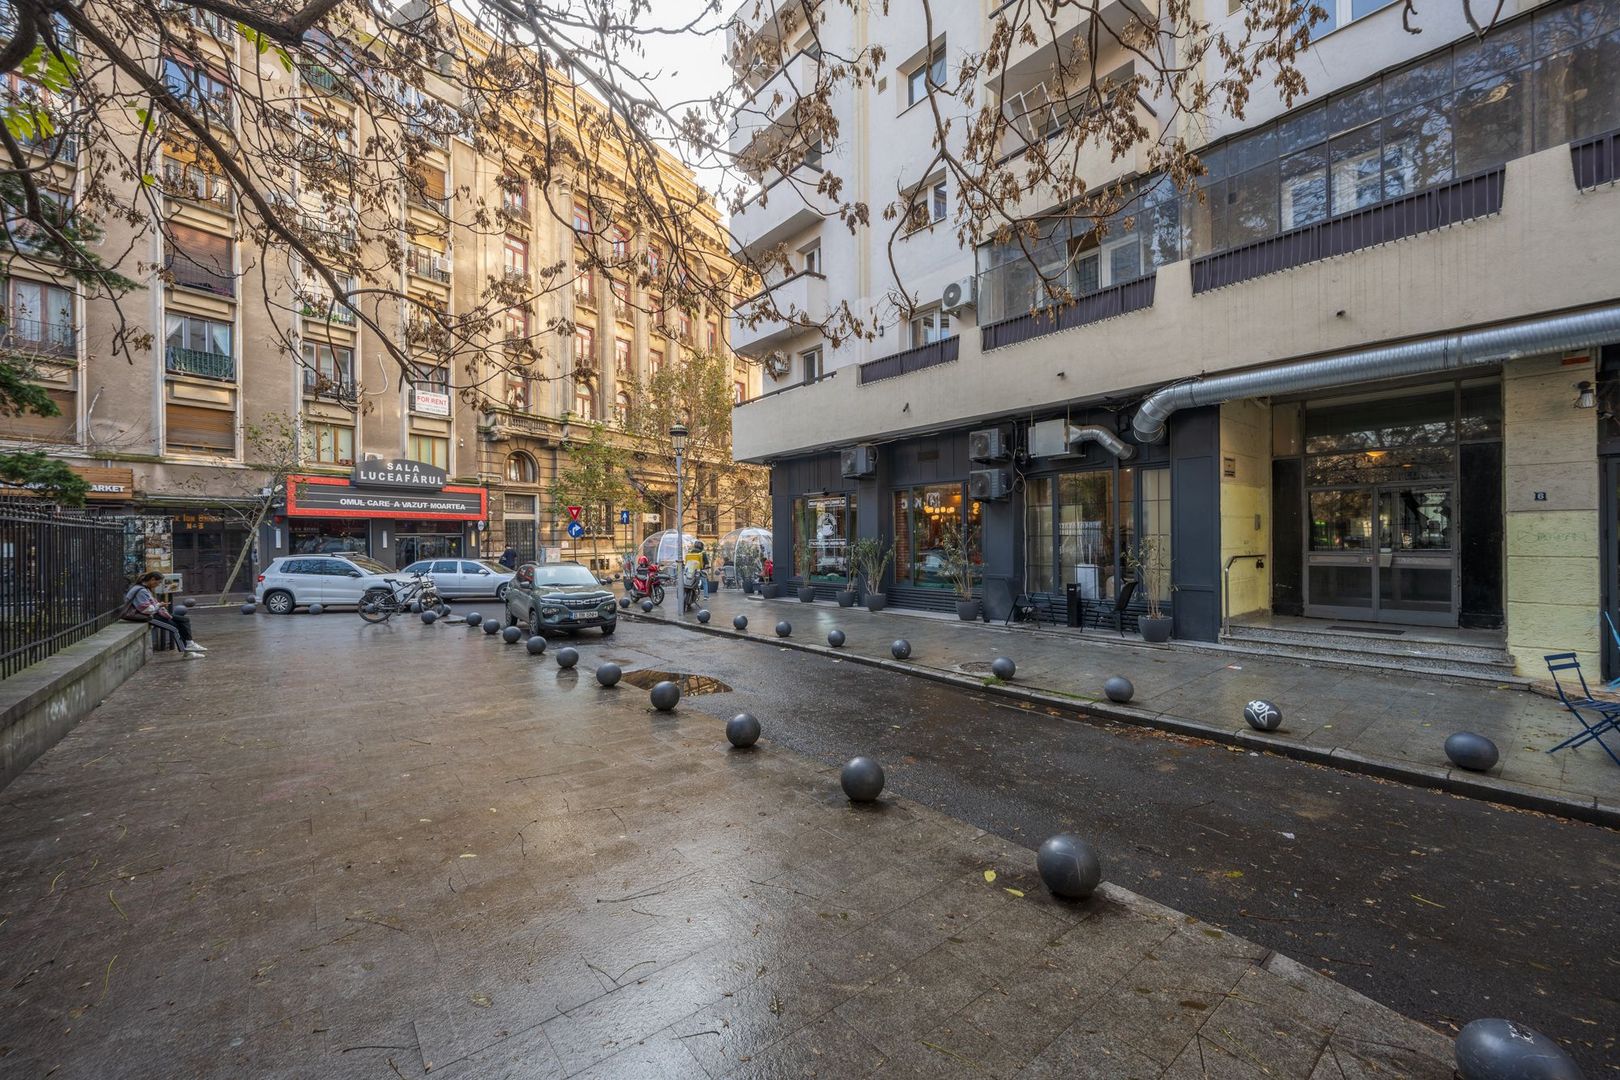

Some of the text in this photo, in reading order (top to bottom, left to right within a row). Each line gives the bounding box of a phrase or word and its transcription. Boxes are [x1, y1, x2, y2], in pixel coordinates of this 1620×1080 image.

[417, 395, 447, 406] FOR RENT
[387, 462, 420, 473] SALA
[360, 470, 443, 485] LUCEAFĂRUL
[340, 498, 366, 506] OMUL
[367, 499, 390, 507] CARE
[402, 501, 428, 509] VAZUT
